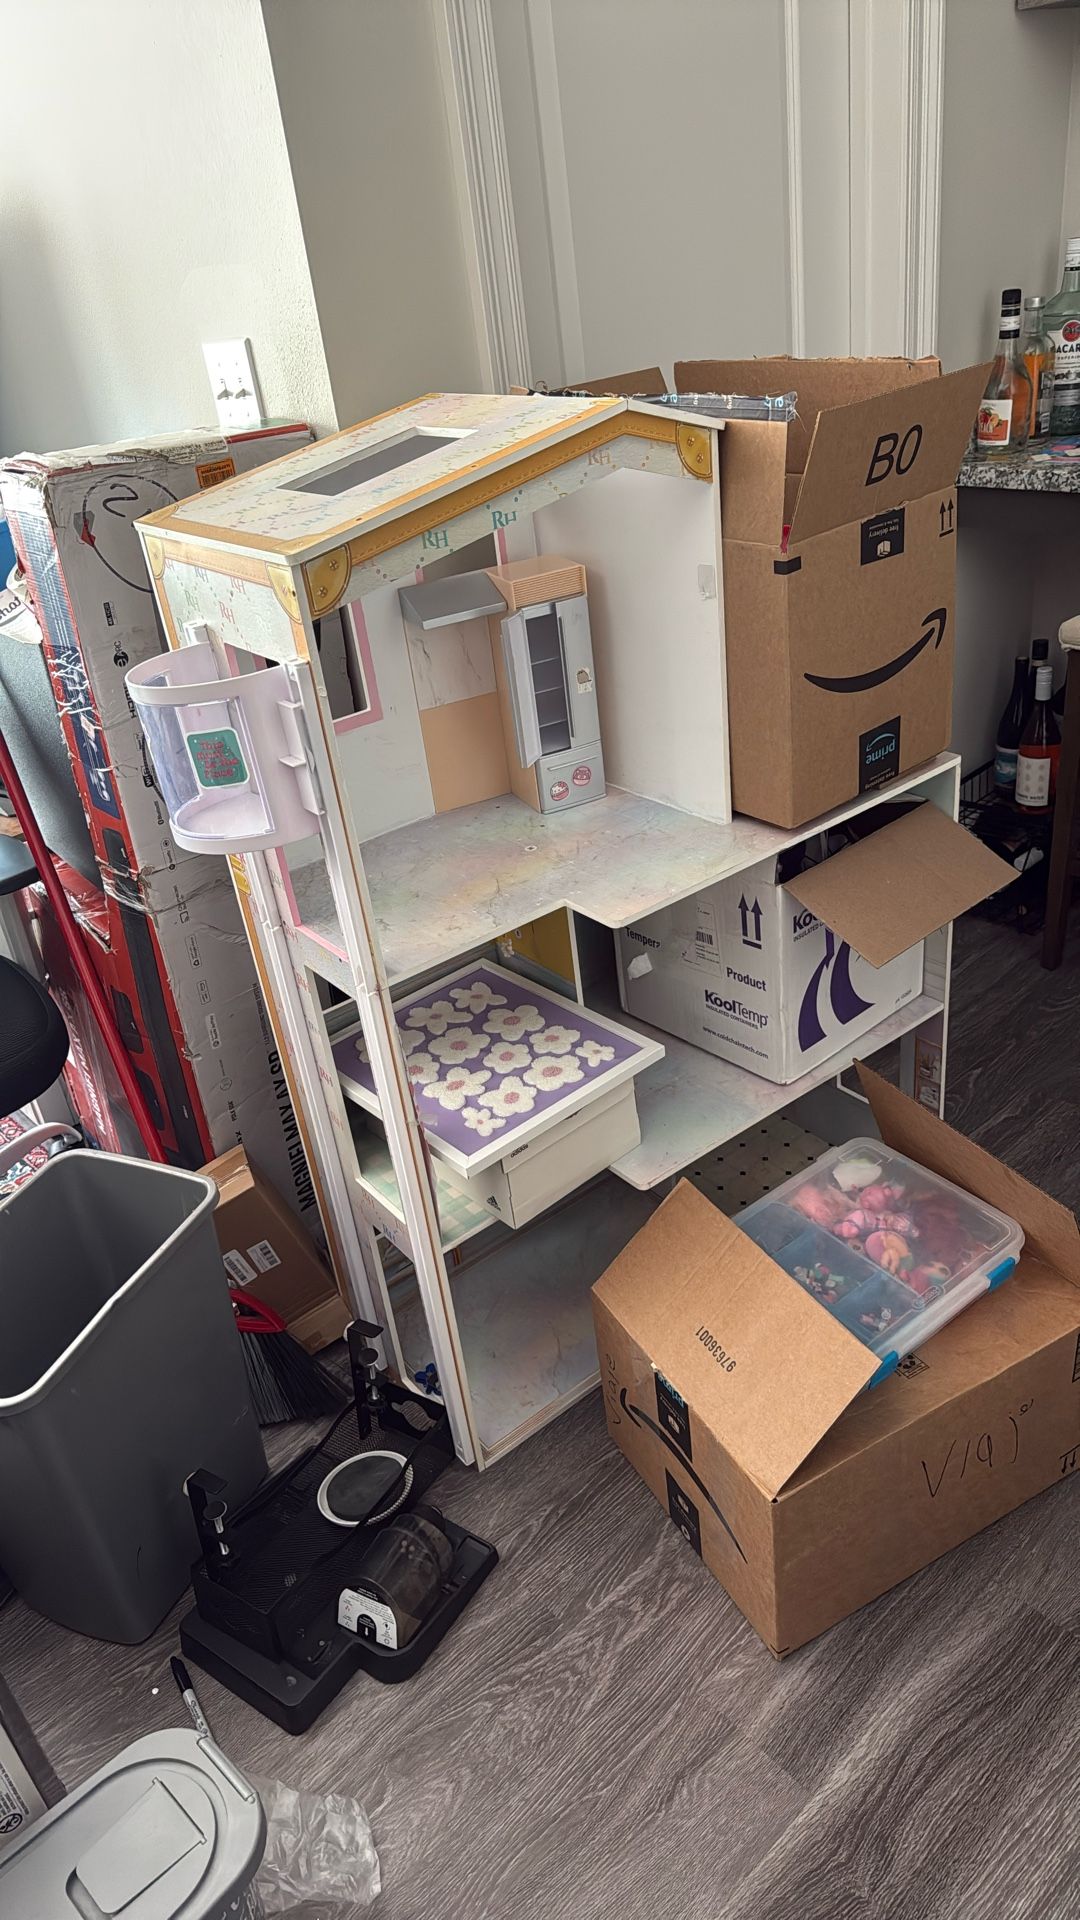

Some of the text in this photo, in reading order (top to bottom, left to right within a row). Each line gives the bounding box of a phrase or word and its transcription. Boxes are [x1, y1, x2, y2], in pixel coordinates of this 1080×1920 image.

[588, 448, 612, 466] RH
[492, 511, 517, 530] RH
[421, 529, 449, 550] RH
[231, 577, 246, 595] RH
[219, 601, 236, 625] RH
[865, 738, 896, 765] prime
[793, 924, 820, 942] INSULATED
[726, 967, 767, 992] Product
[704, 989, 769, 1029] KoolTemp
[705, 1004, 759, 1030] INSULATED CONTAINERS
[702, 1026, 769, 1060] www.coldchaintech.com
[510, 1143, 529, 1158] adidas
[695, 1325, 737, 1373] 97636001
